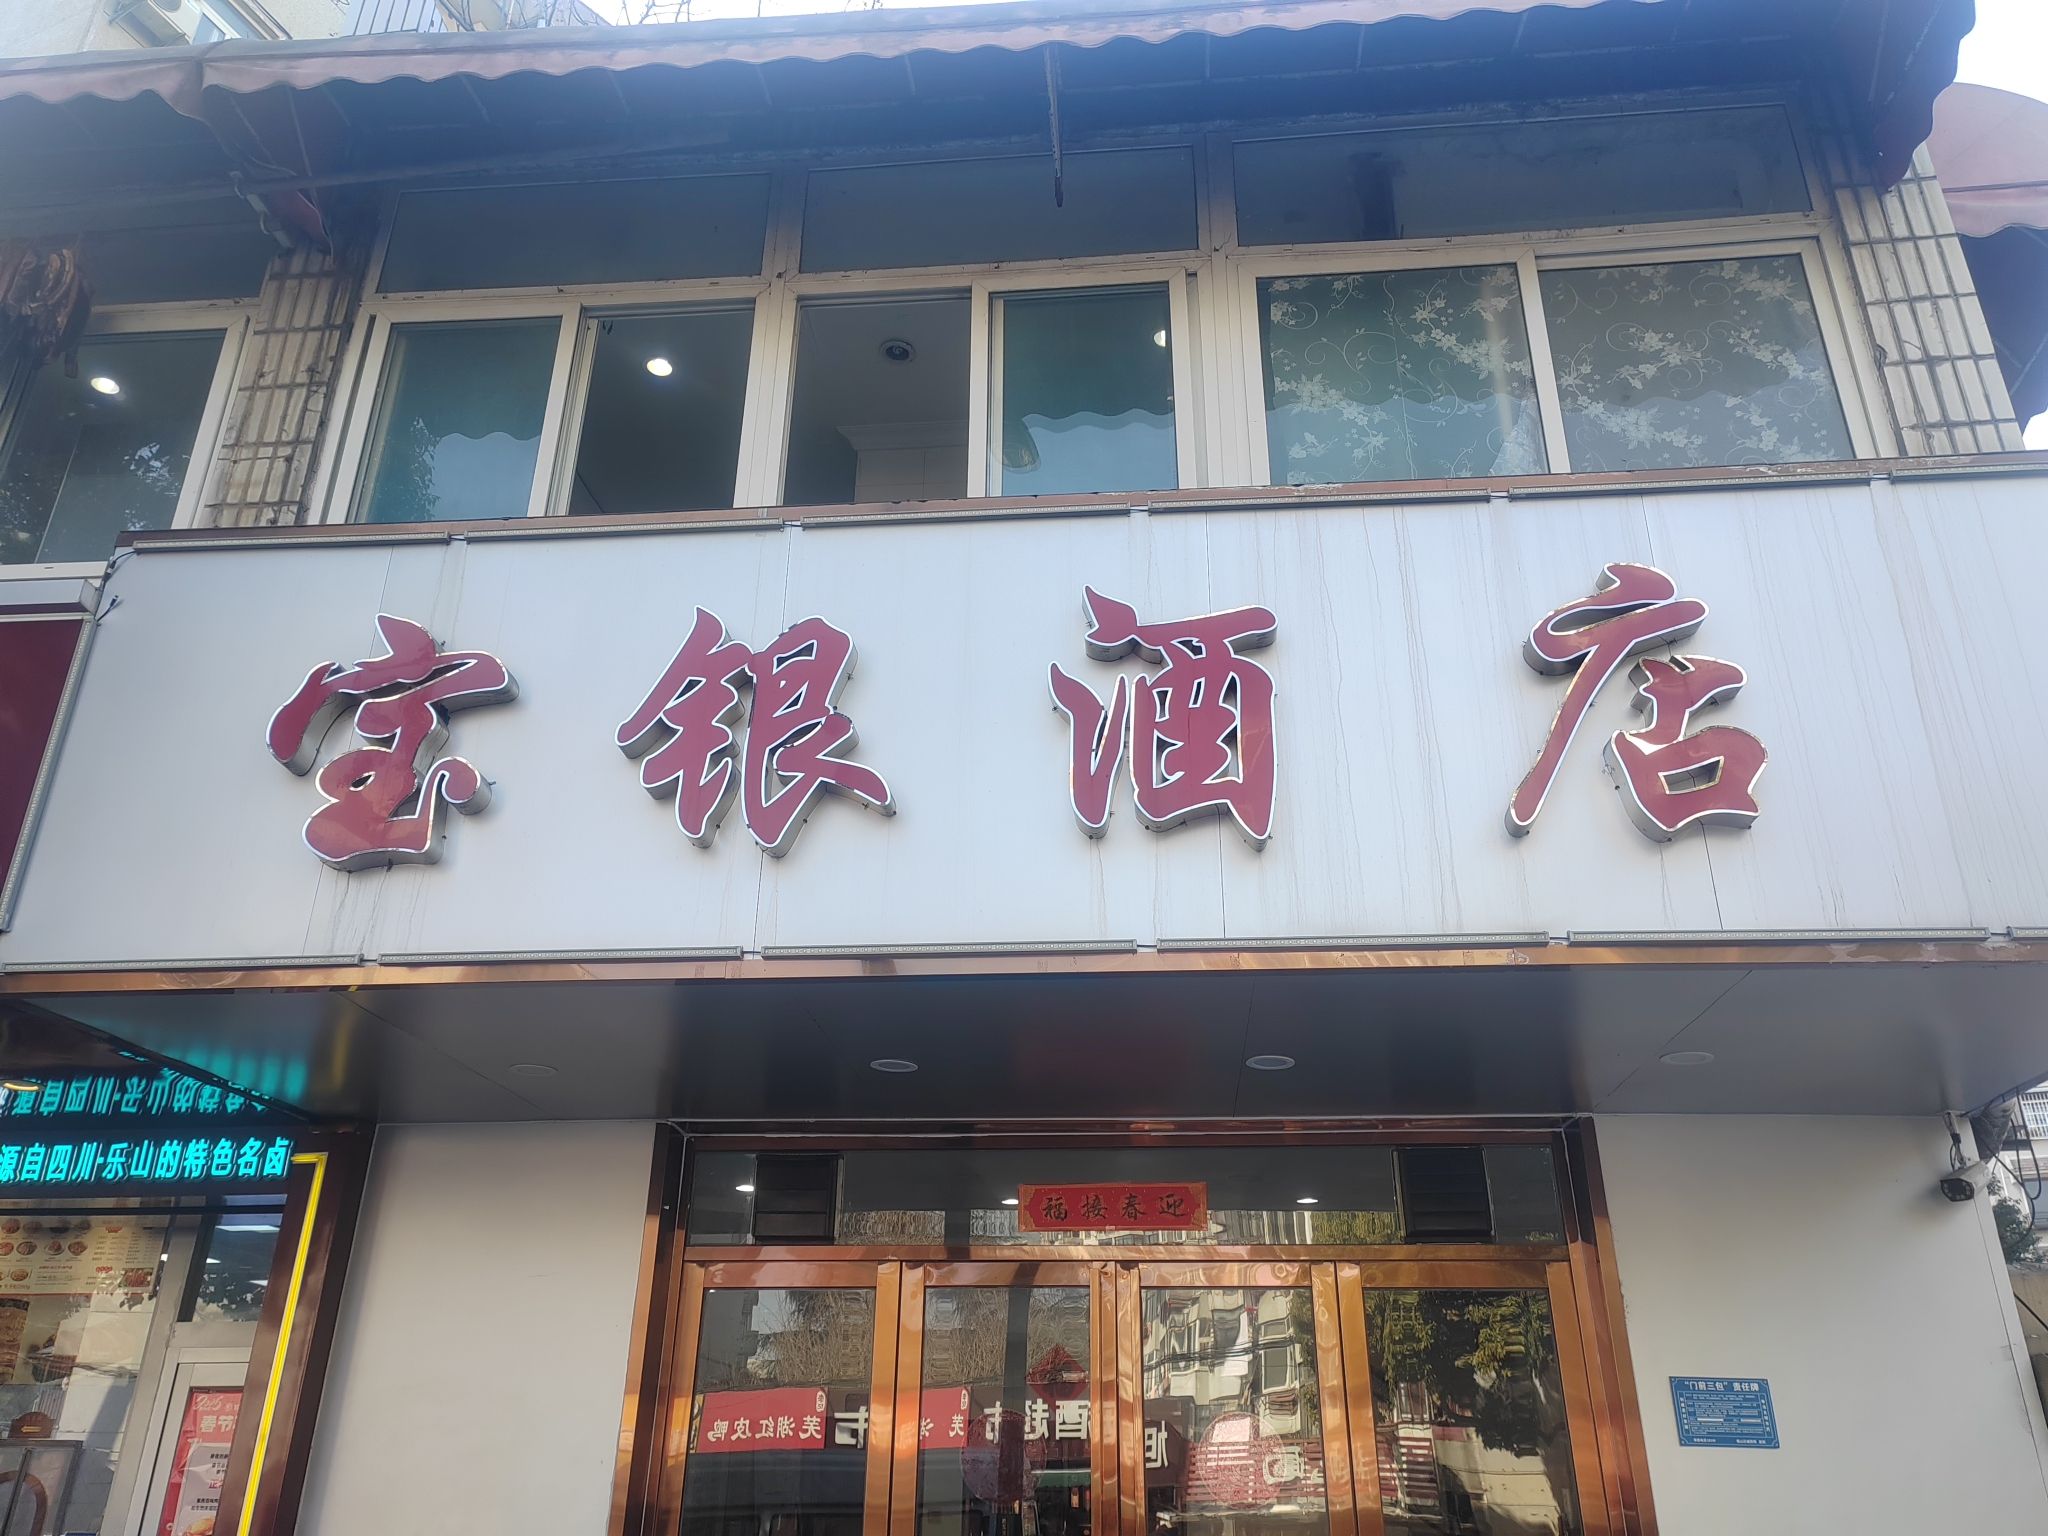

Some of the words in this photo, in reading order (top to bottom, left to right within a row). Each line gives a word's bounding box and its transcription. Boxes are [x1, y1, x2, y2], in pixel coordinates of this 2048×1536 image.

[270, 562, 1767, 868] 宝银酒店
[199, 1414, 237, 1434] 春节
